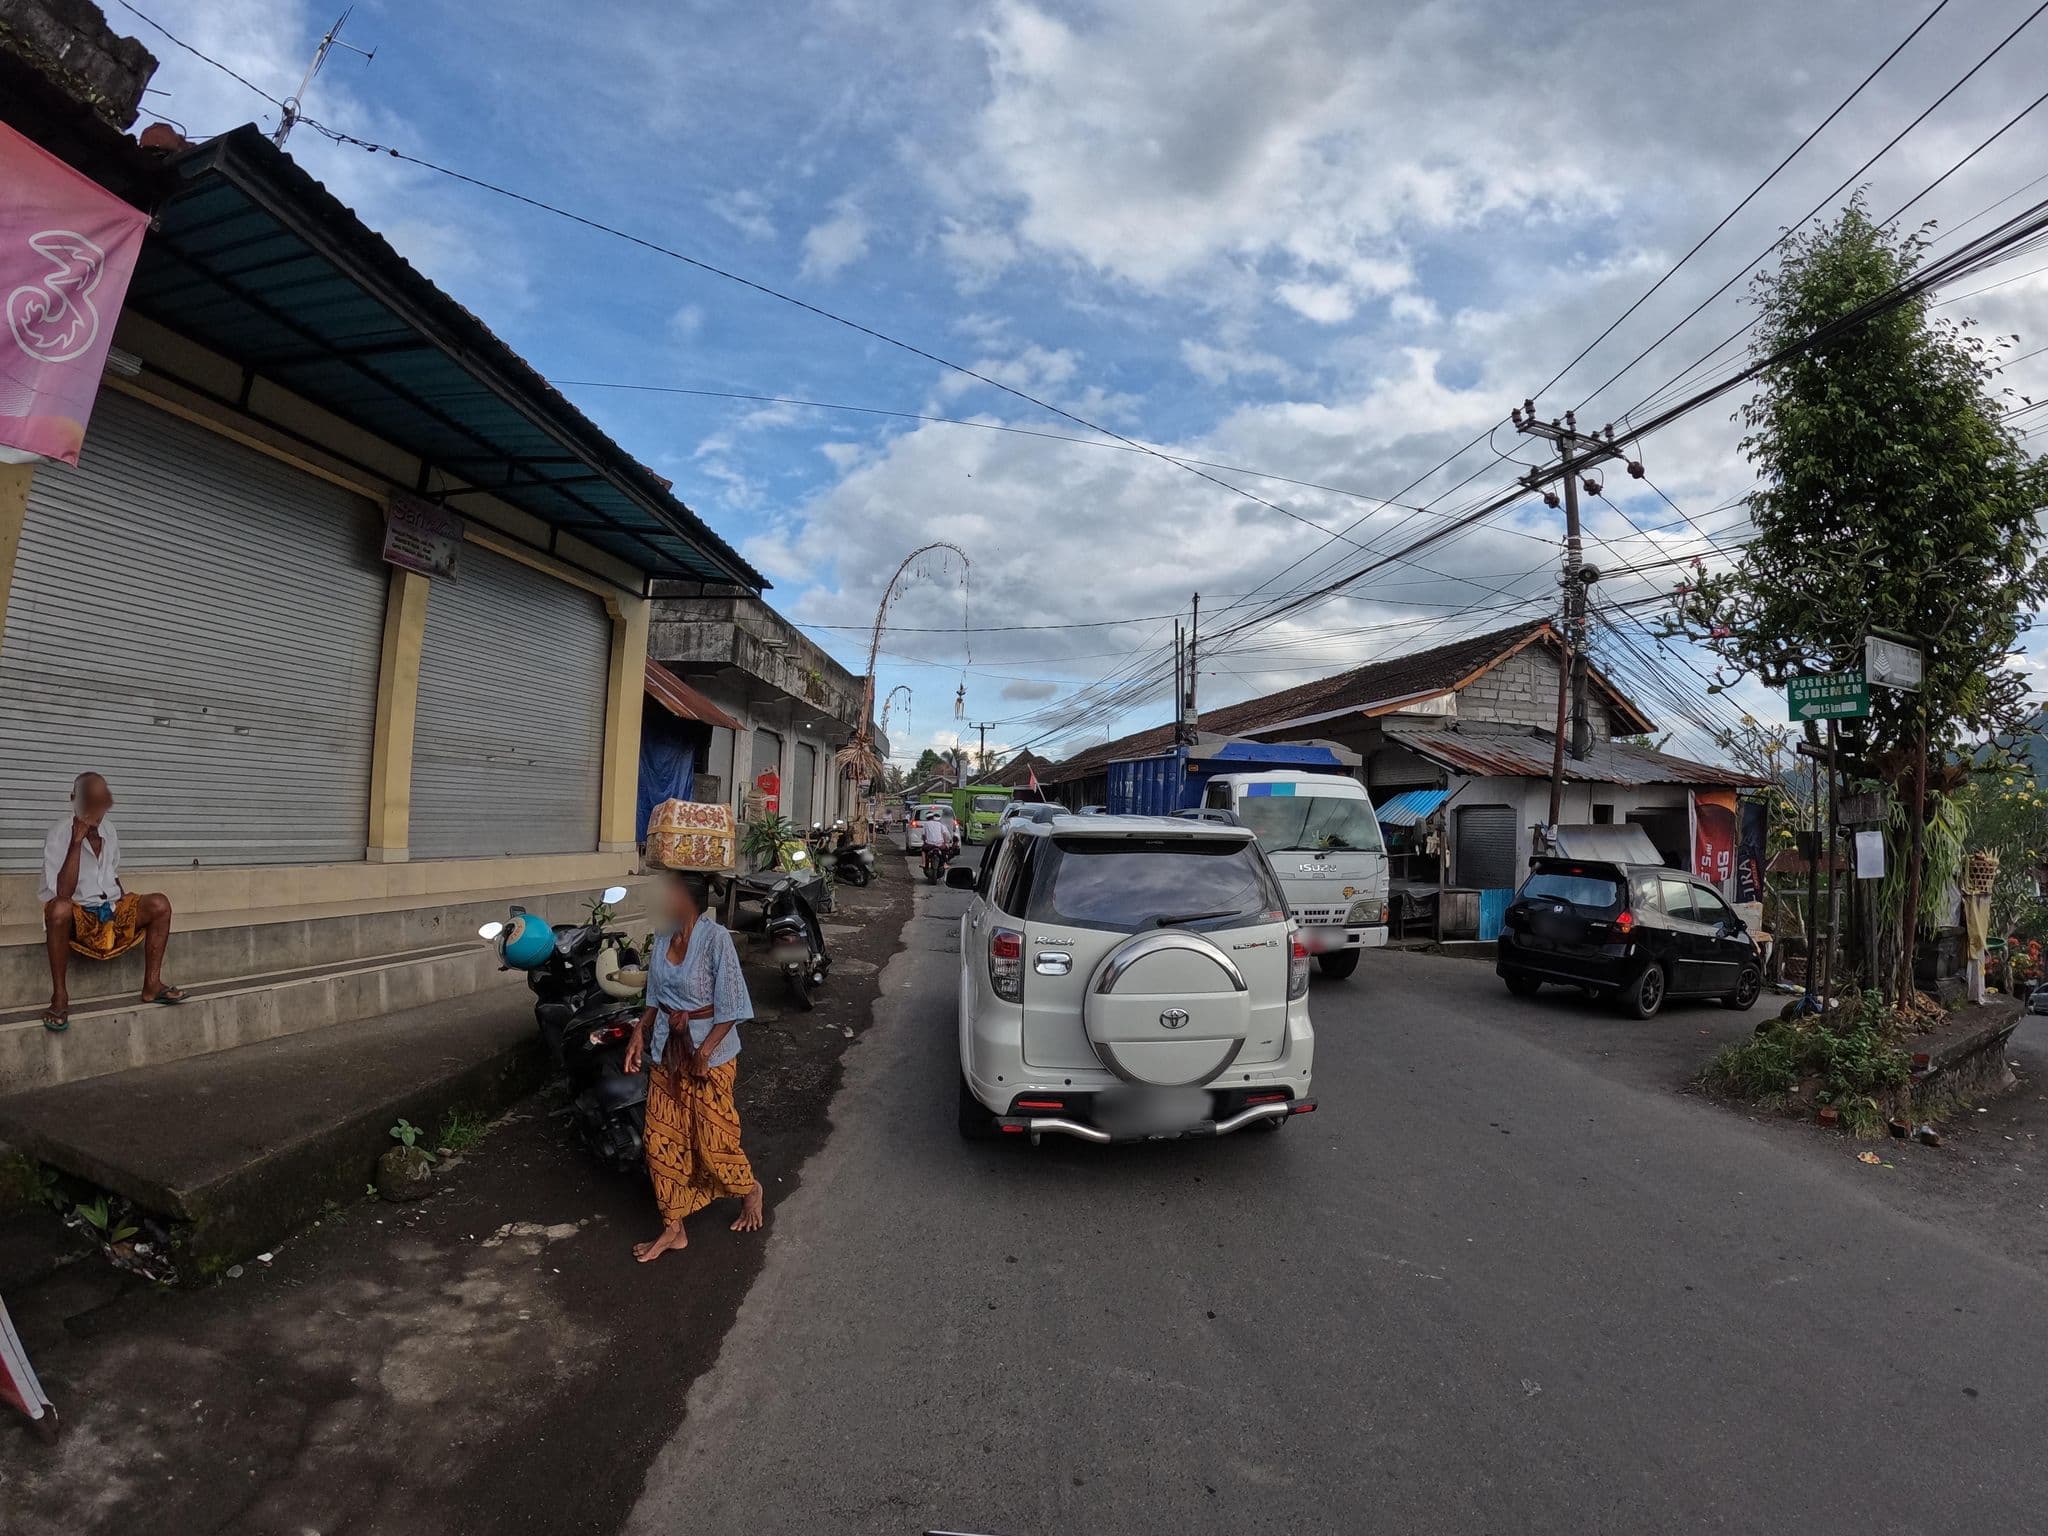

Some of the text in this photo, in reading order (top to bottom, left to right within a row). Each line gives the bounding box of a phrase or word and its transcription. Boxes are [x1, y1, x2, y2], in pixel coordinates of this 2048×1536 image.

[1792, 673, 1862, 689] PUSKESMAS
[1794, 684, 1862, 700] SIDEMEN
[1299, 863, 1337, 873] ISUZU
